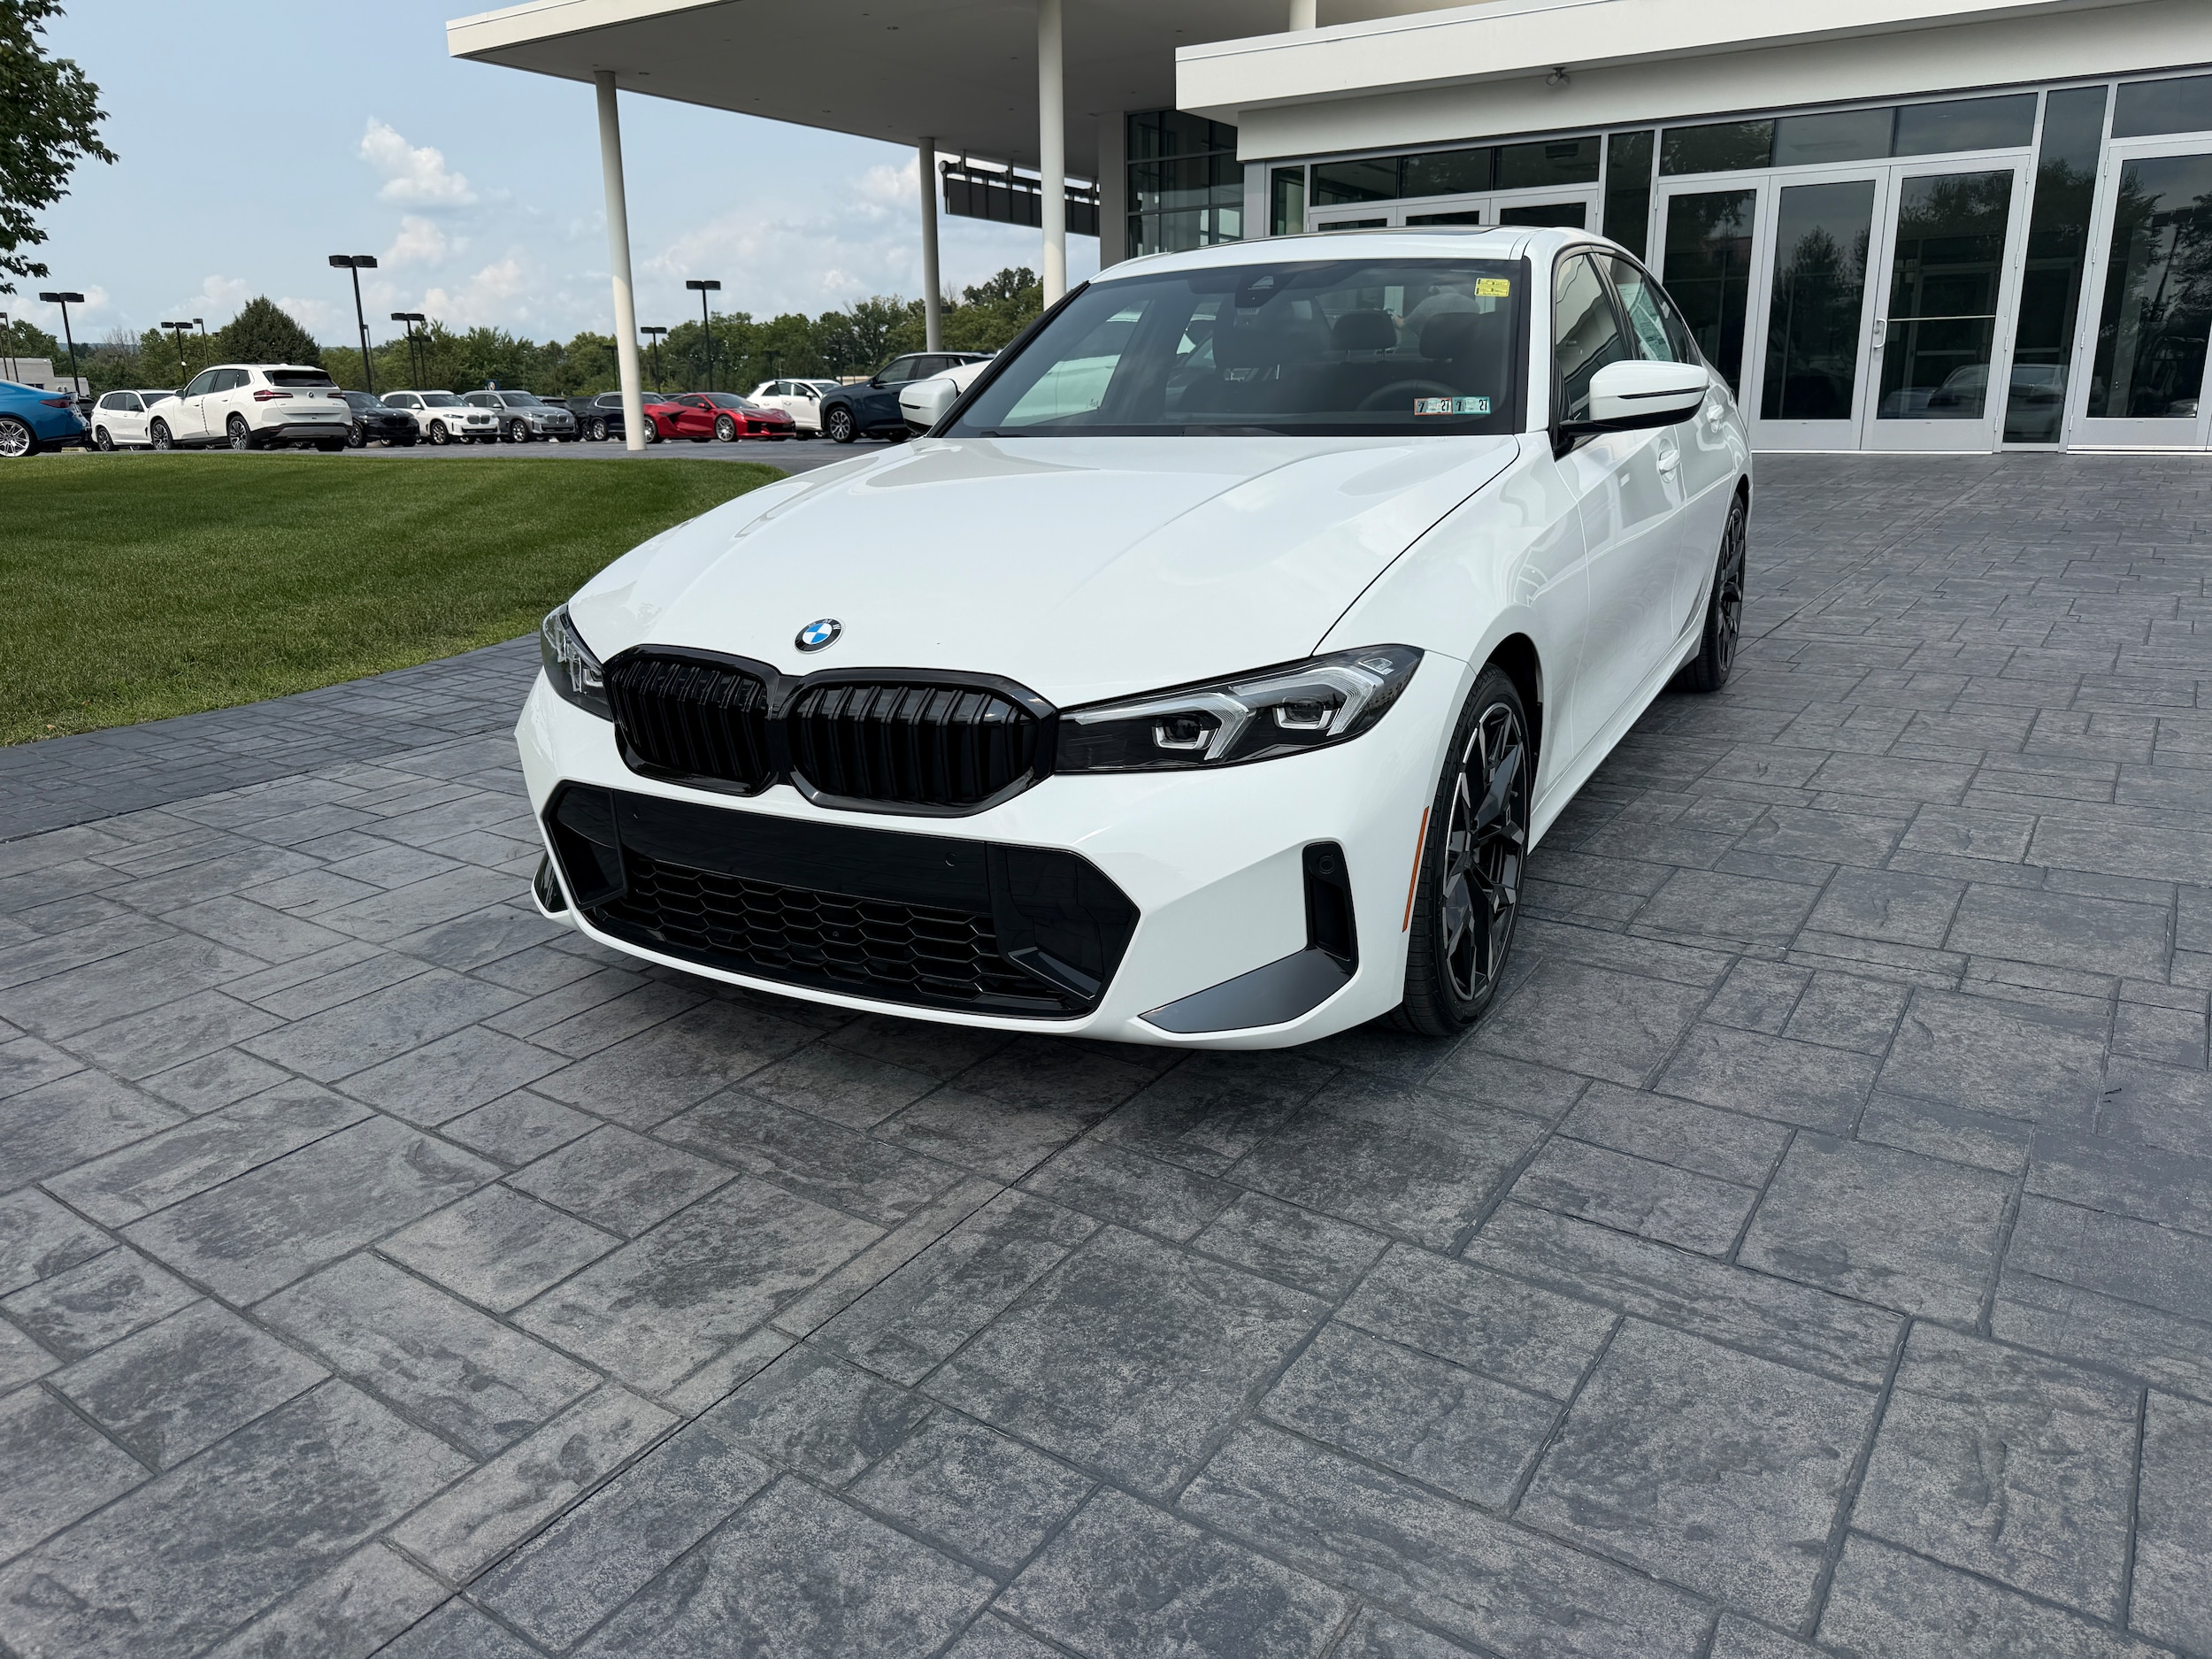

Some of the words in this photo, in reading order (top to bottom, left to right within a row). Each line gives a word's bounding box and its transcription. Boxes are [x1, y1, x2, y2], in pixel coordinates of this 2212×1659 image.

[1418, 403, 1425, 413] 7
[1440, 399, 1449, 411] 27
[1455, 401, 1462, 411] 7
[1479, 399, 1487, 411] 27
